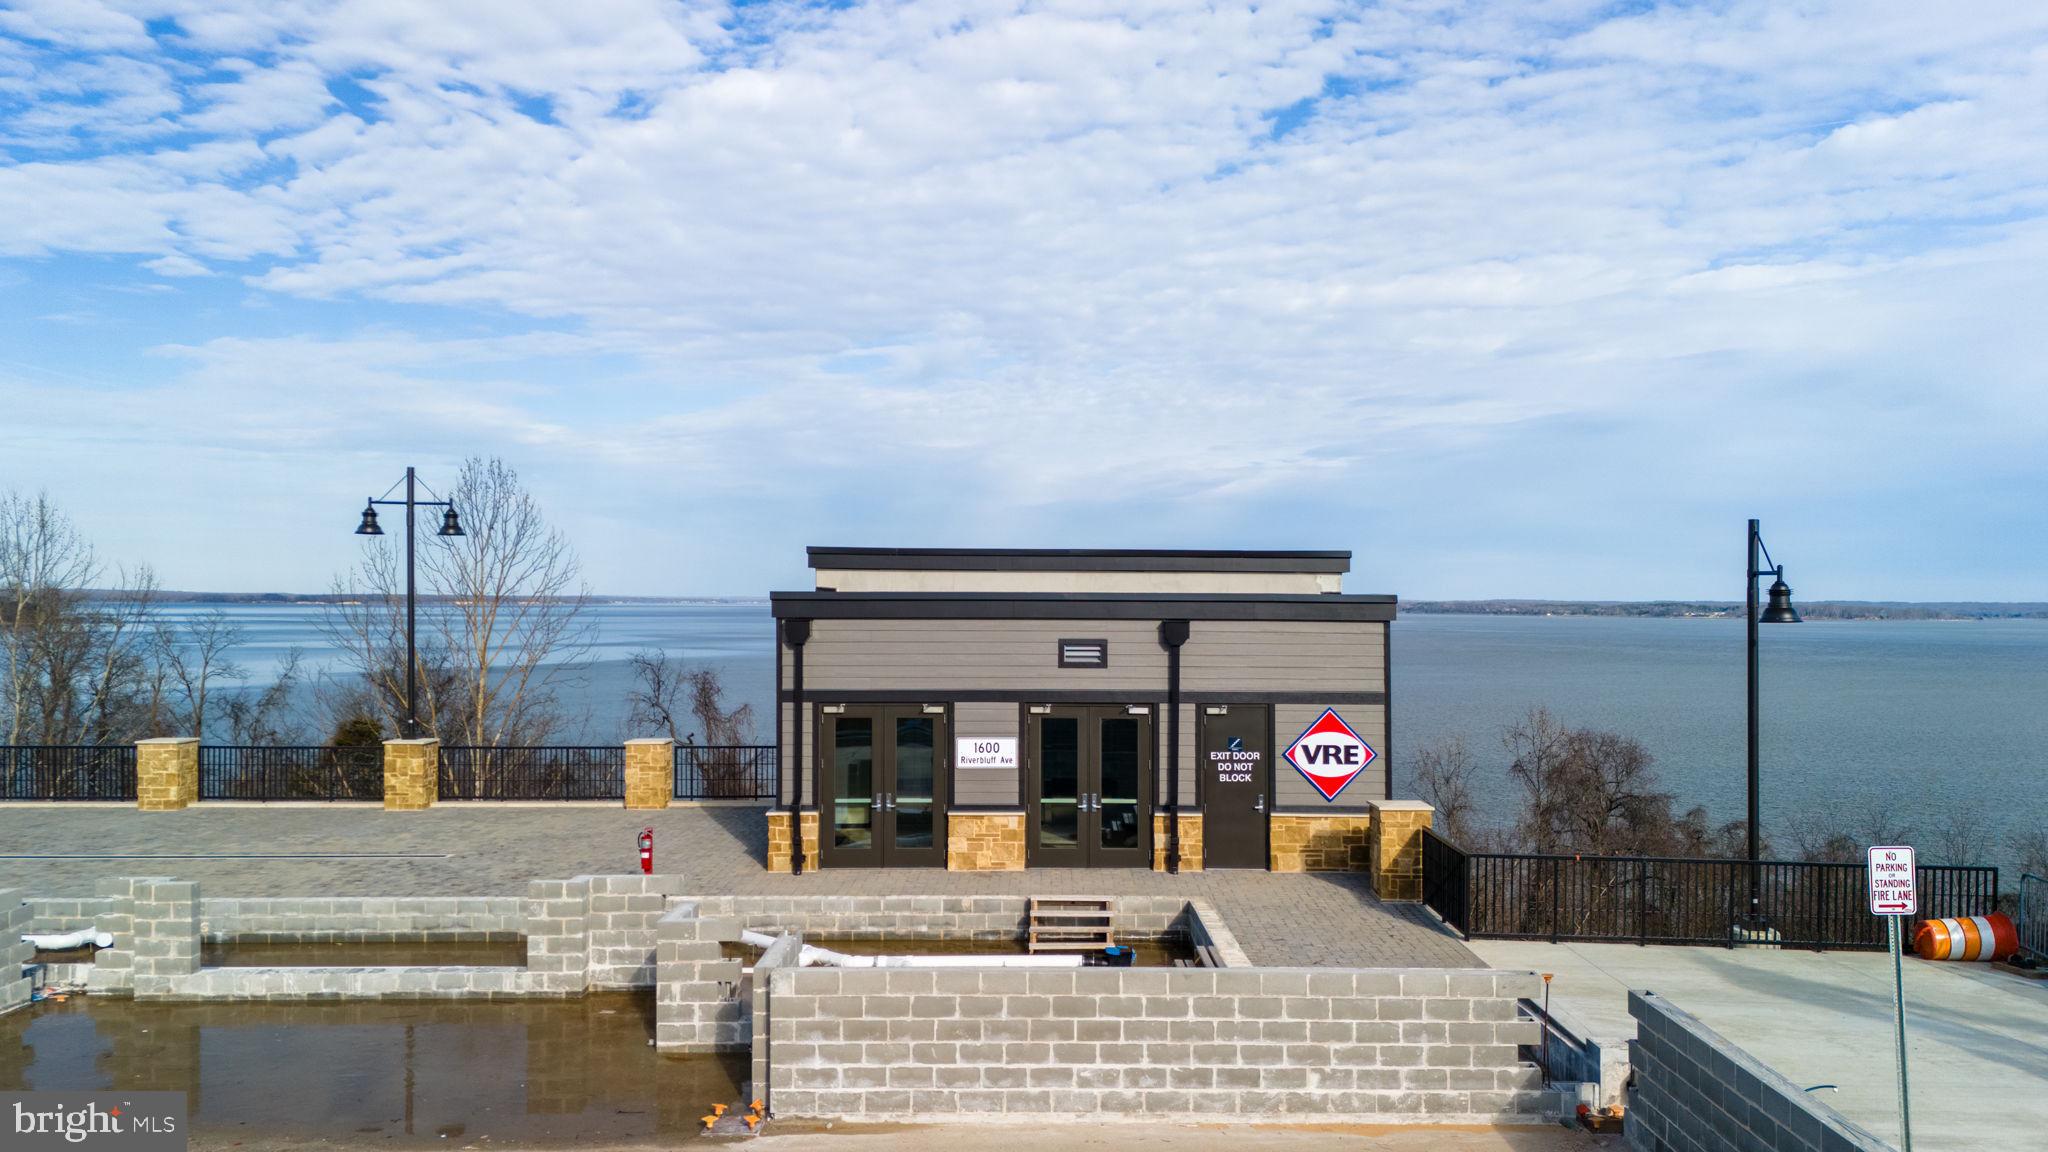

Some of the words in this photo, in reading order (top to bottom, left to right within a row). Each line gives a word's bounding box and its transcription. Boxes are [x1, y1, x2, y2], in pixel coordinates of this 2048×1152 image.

[974, 742, 1000, 753] 1600
[960, 755, 997, 764] Riverbluff
[1000, 756, 1013, 764] Ave
[1210, 751, 1231, 760] EXIT
[1233, 751, 1260, 760] DOOR
[1301, 745, 1359, 765] VRE
[1217, 762, 1232, 771] DO
[1233, 762, 1253, 771] NOT
[1219, 773, 1252, 782] BLOCK
[1885, 852, 1897, 861] NO
[1875, 863, 1908, 872] PARKING
[1874, 880, 1911, 888] STANDING
[1873, 890, 1890, 901] FIRE
[1892, 890, 1913, 901] LANE
